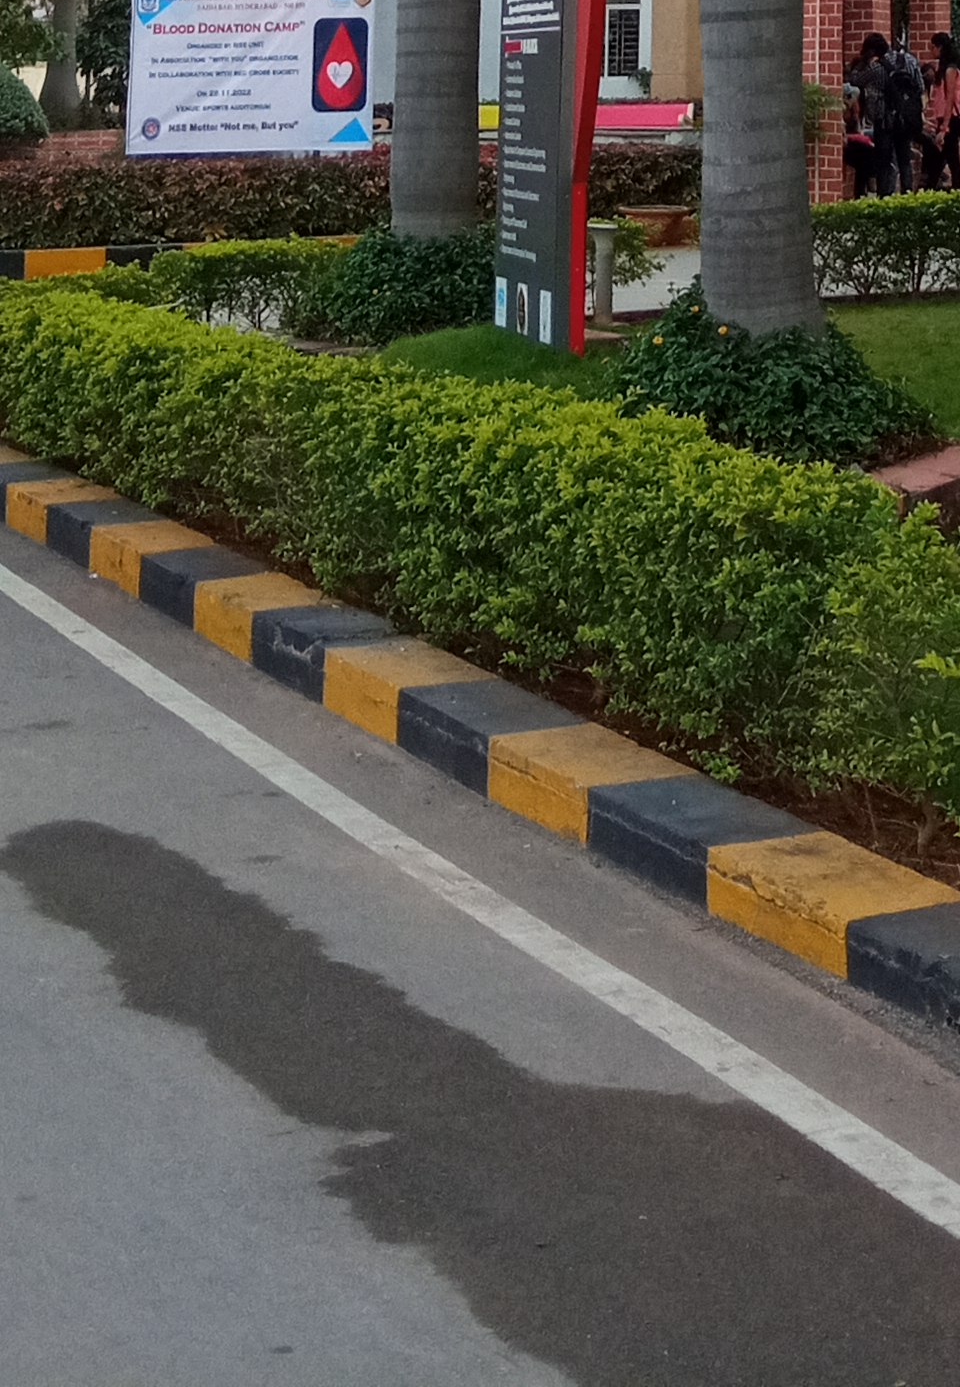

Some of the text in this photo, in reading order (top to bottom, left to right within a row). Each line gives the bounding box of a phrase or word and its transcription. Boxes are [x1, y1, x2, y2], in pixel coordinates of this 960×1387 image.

[147, 20, 305, 35] "BLOOD DONATION CAMP"
